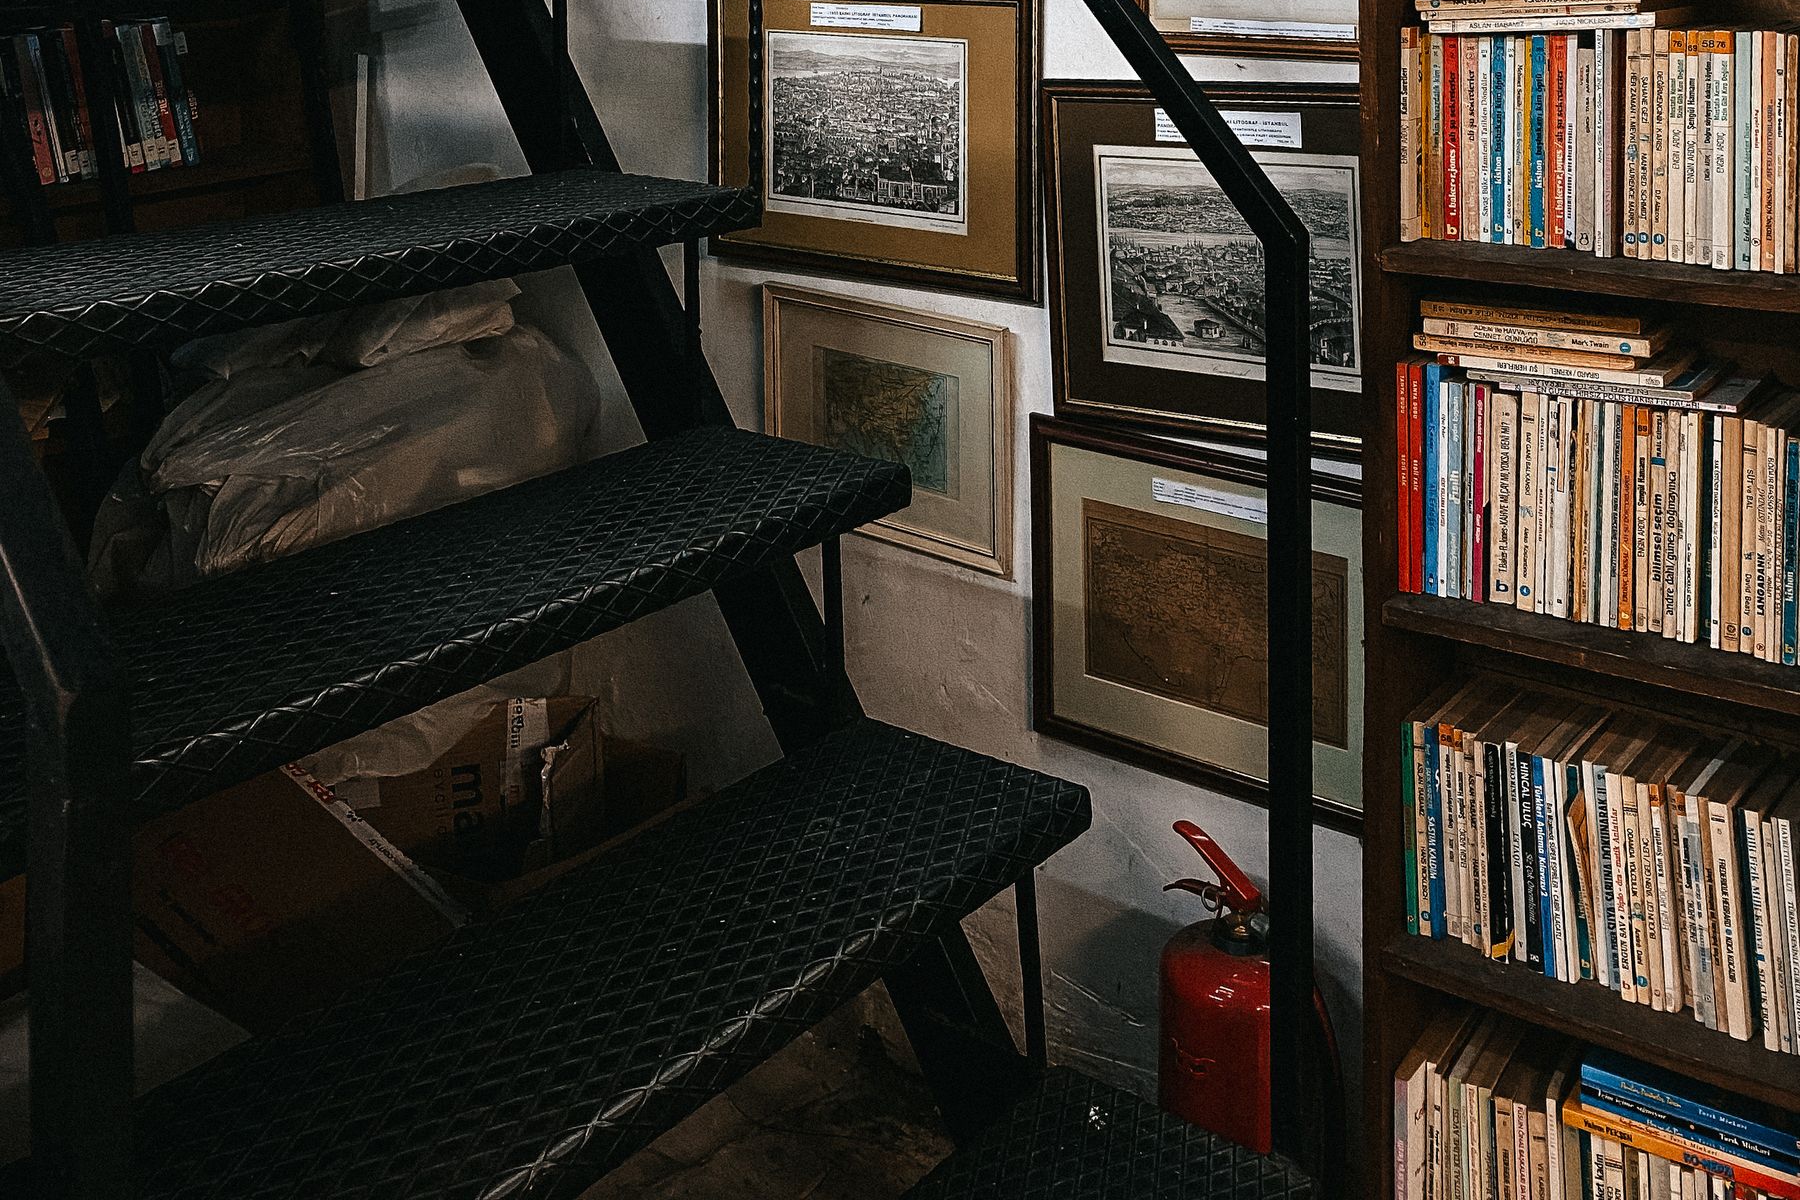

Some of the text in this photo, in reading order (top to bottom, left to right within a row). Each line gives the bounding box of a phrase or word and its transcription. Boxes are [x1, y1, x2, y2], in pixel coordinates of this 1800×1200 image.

[1629, 72, 1637, 114] HER ZAMAN
[1640, 106, 1650, 124] GEZİ
[1686, 106, 1697, 130] Şengül
[1494, 156, 1503, 185] kishon
[1534, 159, 1543, 189] kishon
[1627, 162, 1636, 226] LAURENCE MARKS
[1588, 340, 1610, 349] Twain
[1745, 495, 1754, 510] BAL
[1652, 493, 1664, 583] bilimsel seçim
[1665, 471, 1678, 616] andre doğmayınca
[1744, 573, 1752, 595] David
[1756, 552, 1765, 617] LANGADANK
[1784, 571, 1795, 603] kishon
[1519, 761, 1532, 829] HINCAL ULUÇ
[1533, 784, 1544, 820] Türkleri
[1536, 821, 1546, 854] Anlama
[1619, 920, 1630, 970] ERGUN SAV
